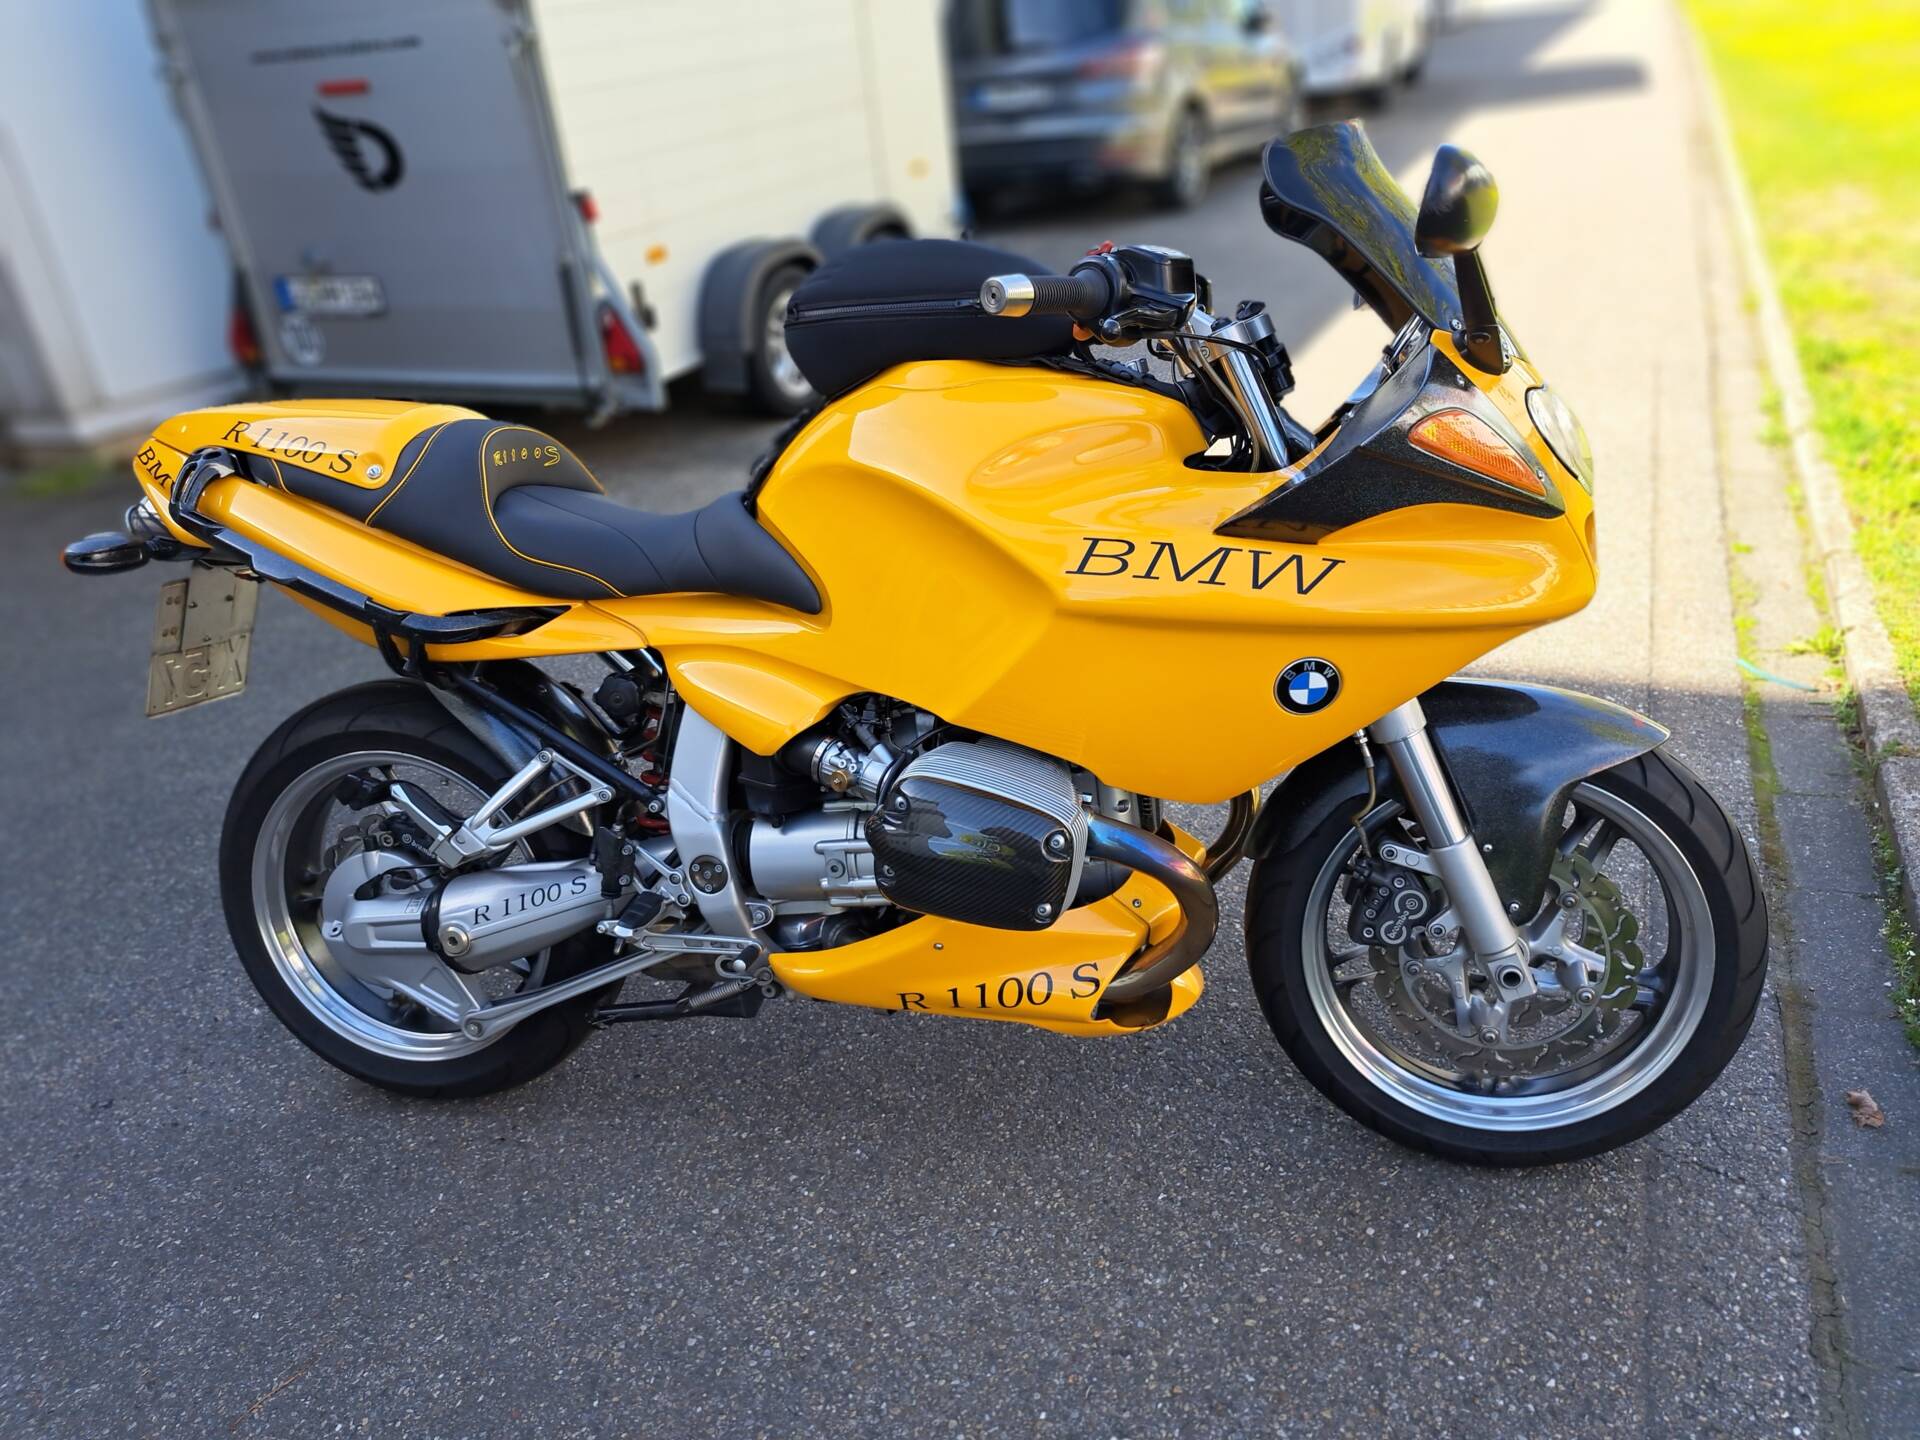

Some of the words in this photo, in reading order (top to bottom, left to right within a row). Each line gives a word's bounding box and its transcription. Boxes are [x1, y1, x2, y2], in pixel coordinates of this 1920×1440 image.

[137, 446, 175, 490] BM
[221, 420, 250, 443] R
[251, 427, 327, 464] 1100
[329, 449, 359, 474] S
[1065, 537, 1346, 595] BMW
[1284, 661, 1336, 681] BMW
[473, 905, 491, 925] R
[503, 883, 562, 917] 1100
[571, 875, 587, 895] S
[897, 992, 931, 1010] R
[947, 971, 1054, 1009] 1100
[1071, 962, 1100, 1000] S
